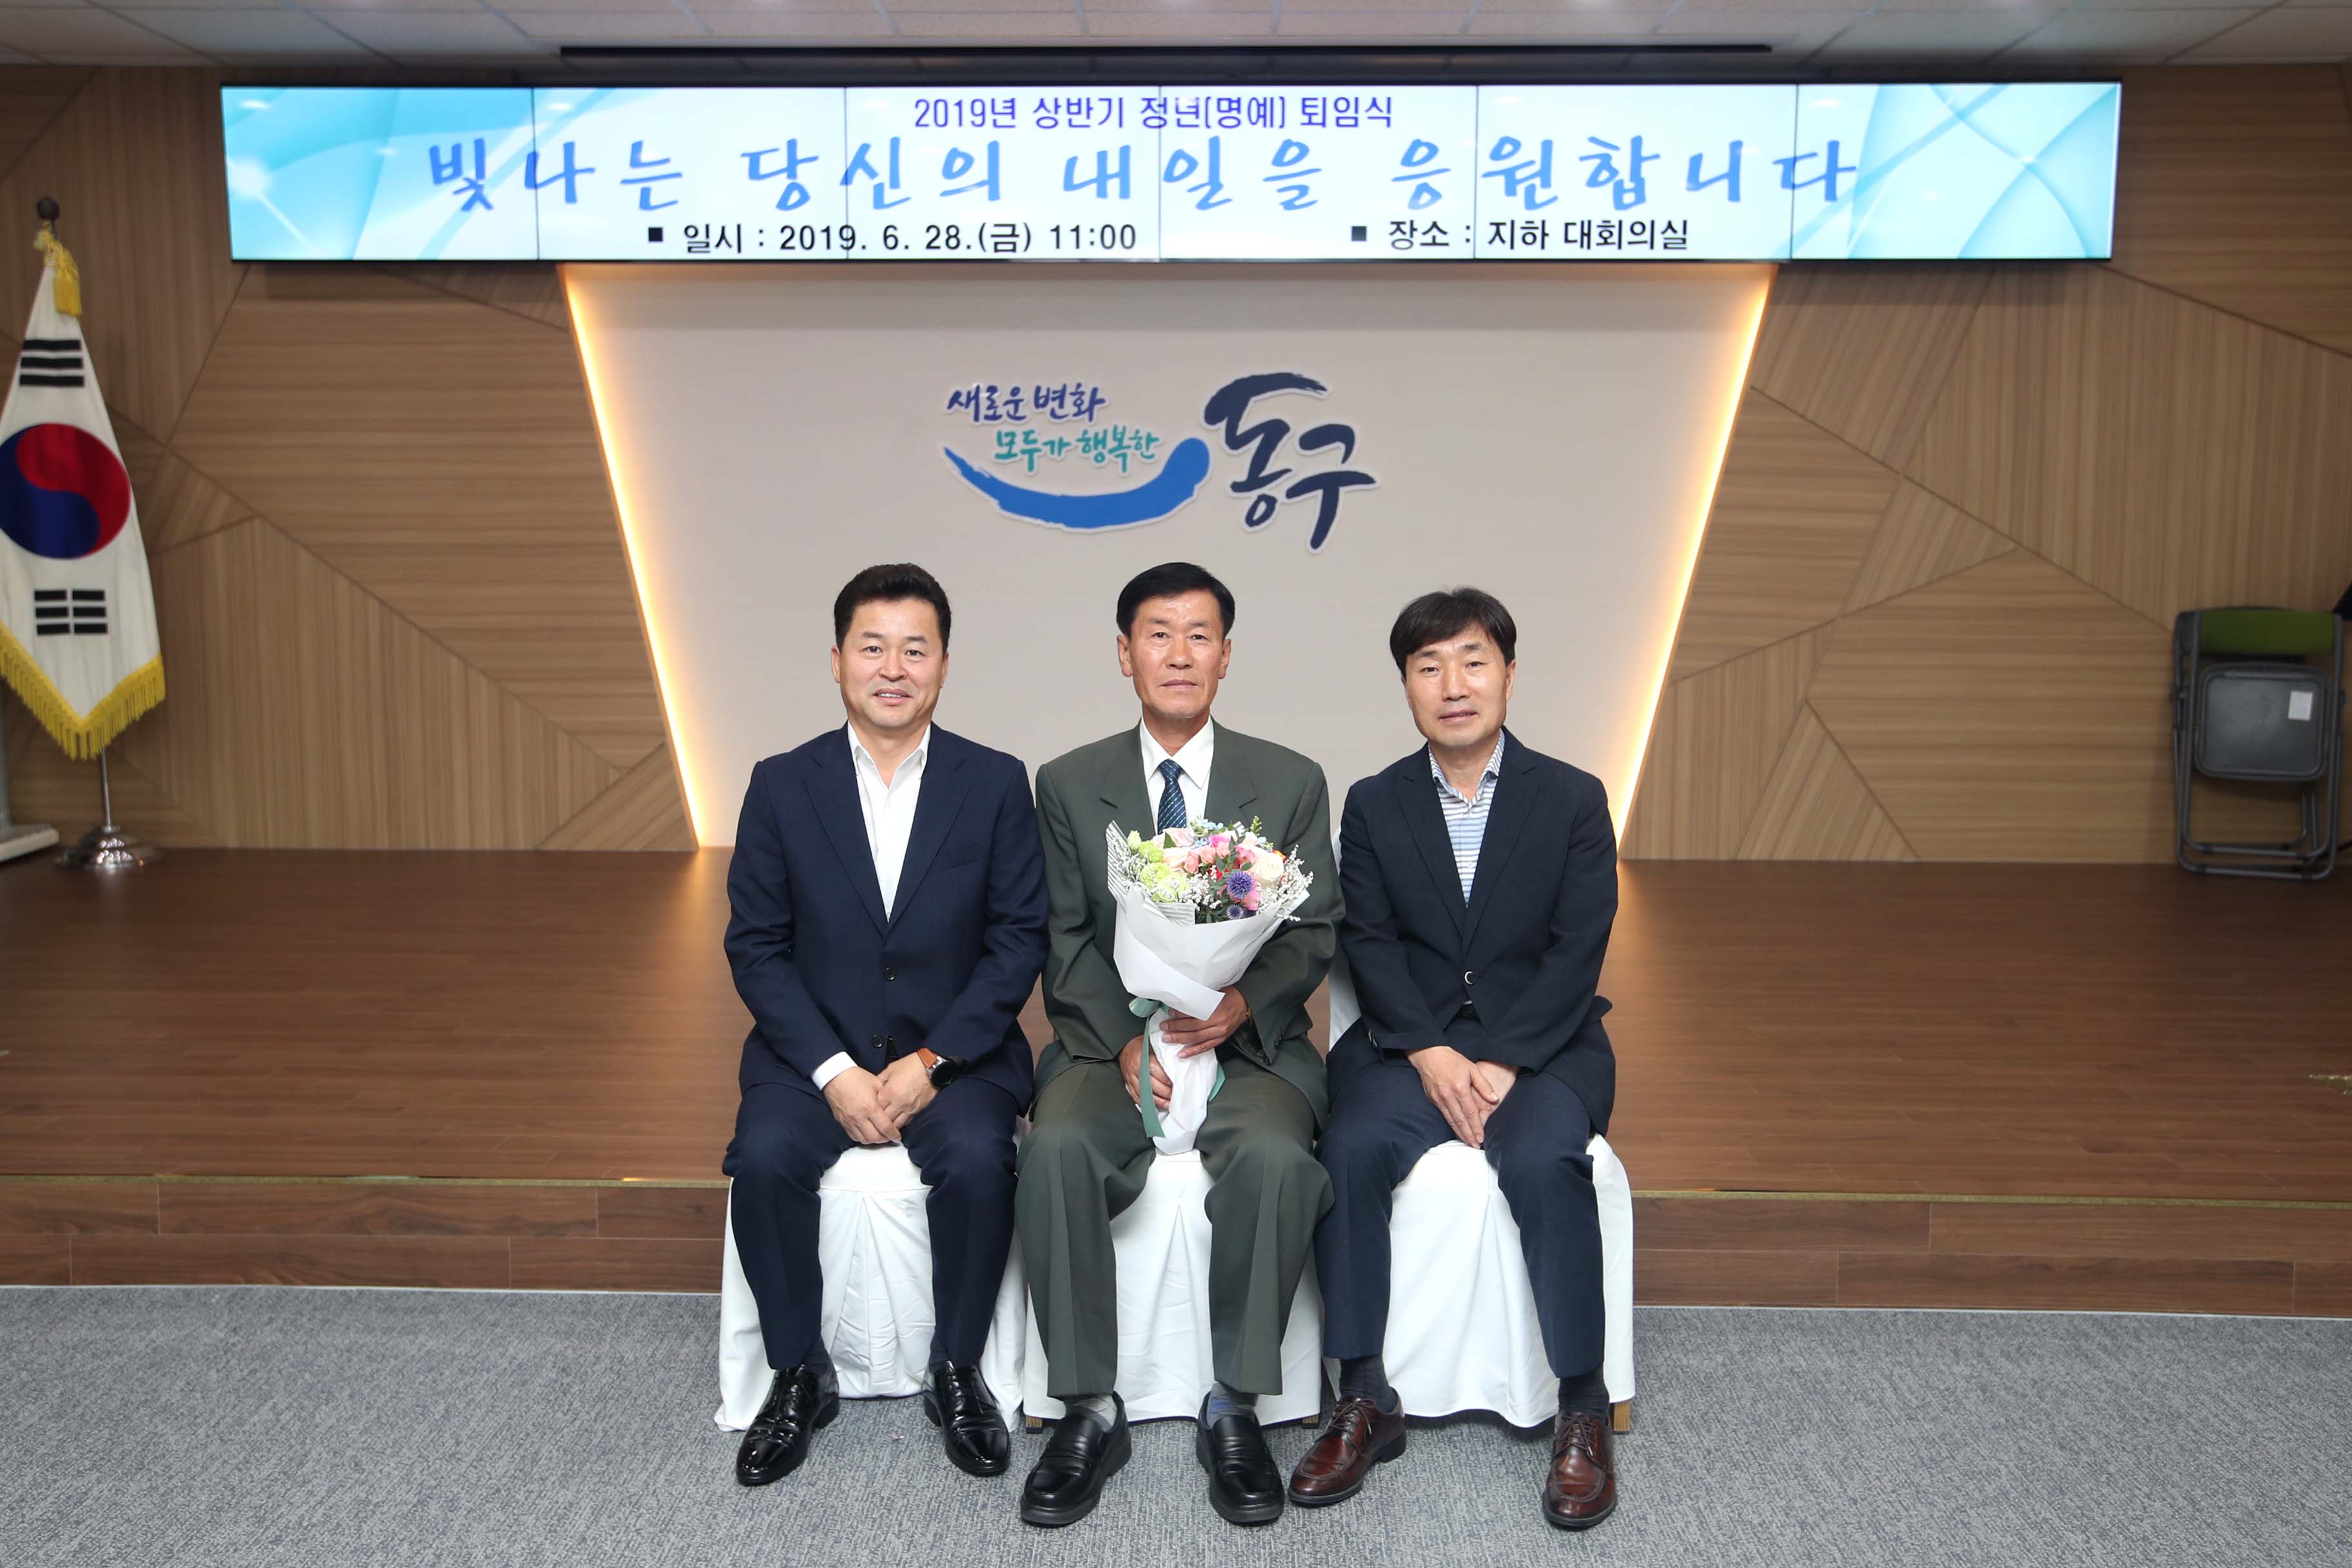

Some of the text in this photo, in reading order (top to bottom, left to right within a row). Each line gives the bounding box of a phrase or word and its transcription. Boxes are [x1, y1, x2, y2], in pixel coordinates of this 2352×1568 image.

[914, 97, 1016, 128] 2019년
[1033, 97, 1124, 130] 상반기
[1299, 97, 1392, 129] 퇴임식
[427, 135, 1857, 213] 빛나는 당신의 내일을 응원합니다
[683, 224, 742, 253] 일시
[779, 224, 867, 251] 2019.
[882, 224, 910, 250] 6.
[925, 222, 1032, 253] 28.(금)
[1050, 224, 1136, 250] 11:00
[1389, 219, 1451, 251] 장소
[1487, 219, 1550, 251] 지하
[1563, 219, 1689, 251] 대회의실
[947, 382, 1106, 423] 새로운 변화
[994, 425, 1161, 473] 모두가 행복한
[1203, 371, 1377, 550] 동구
